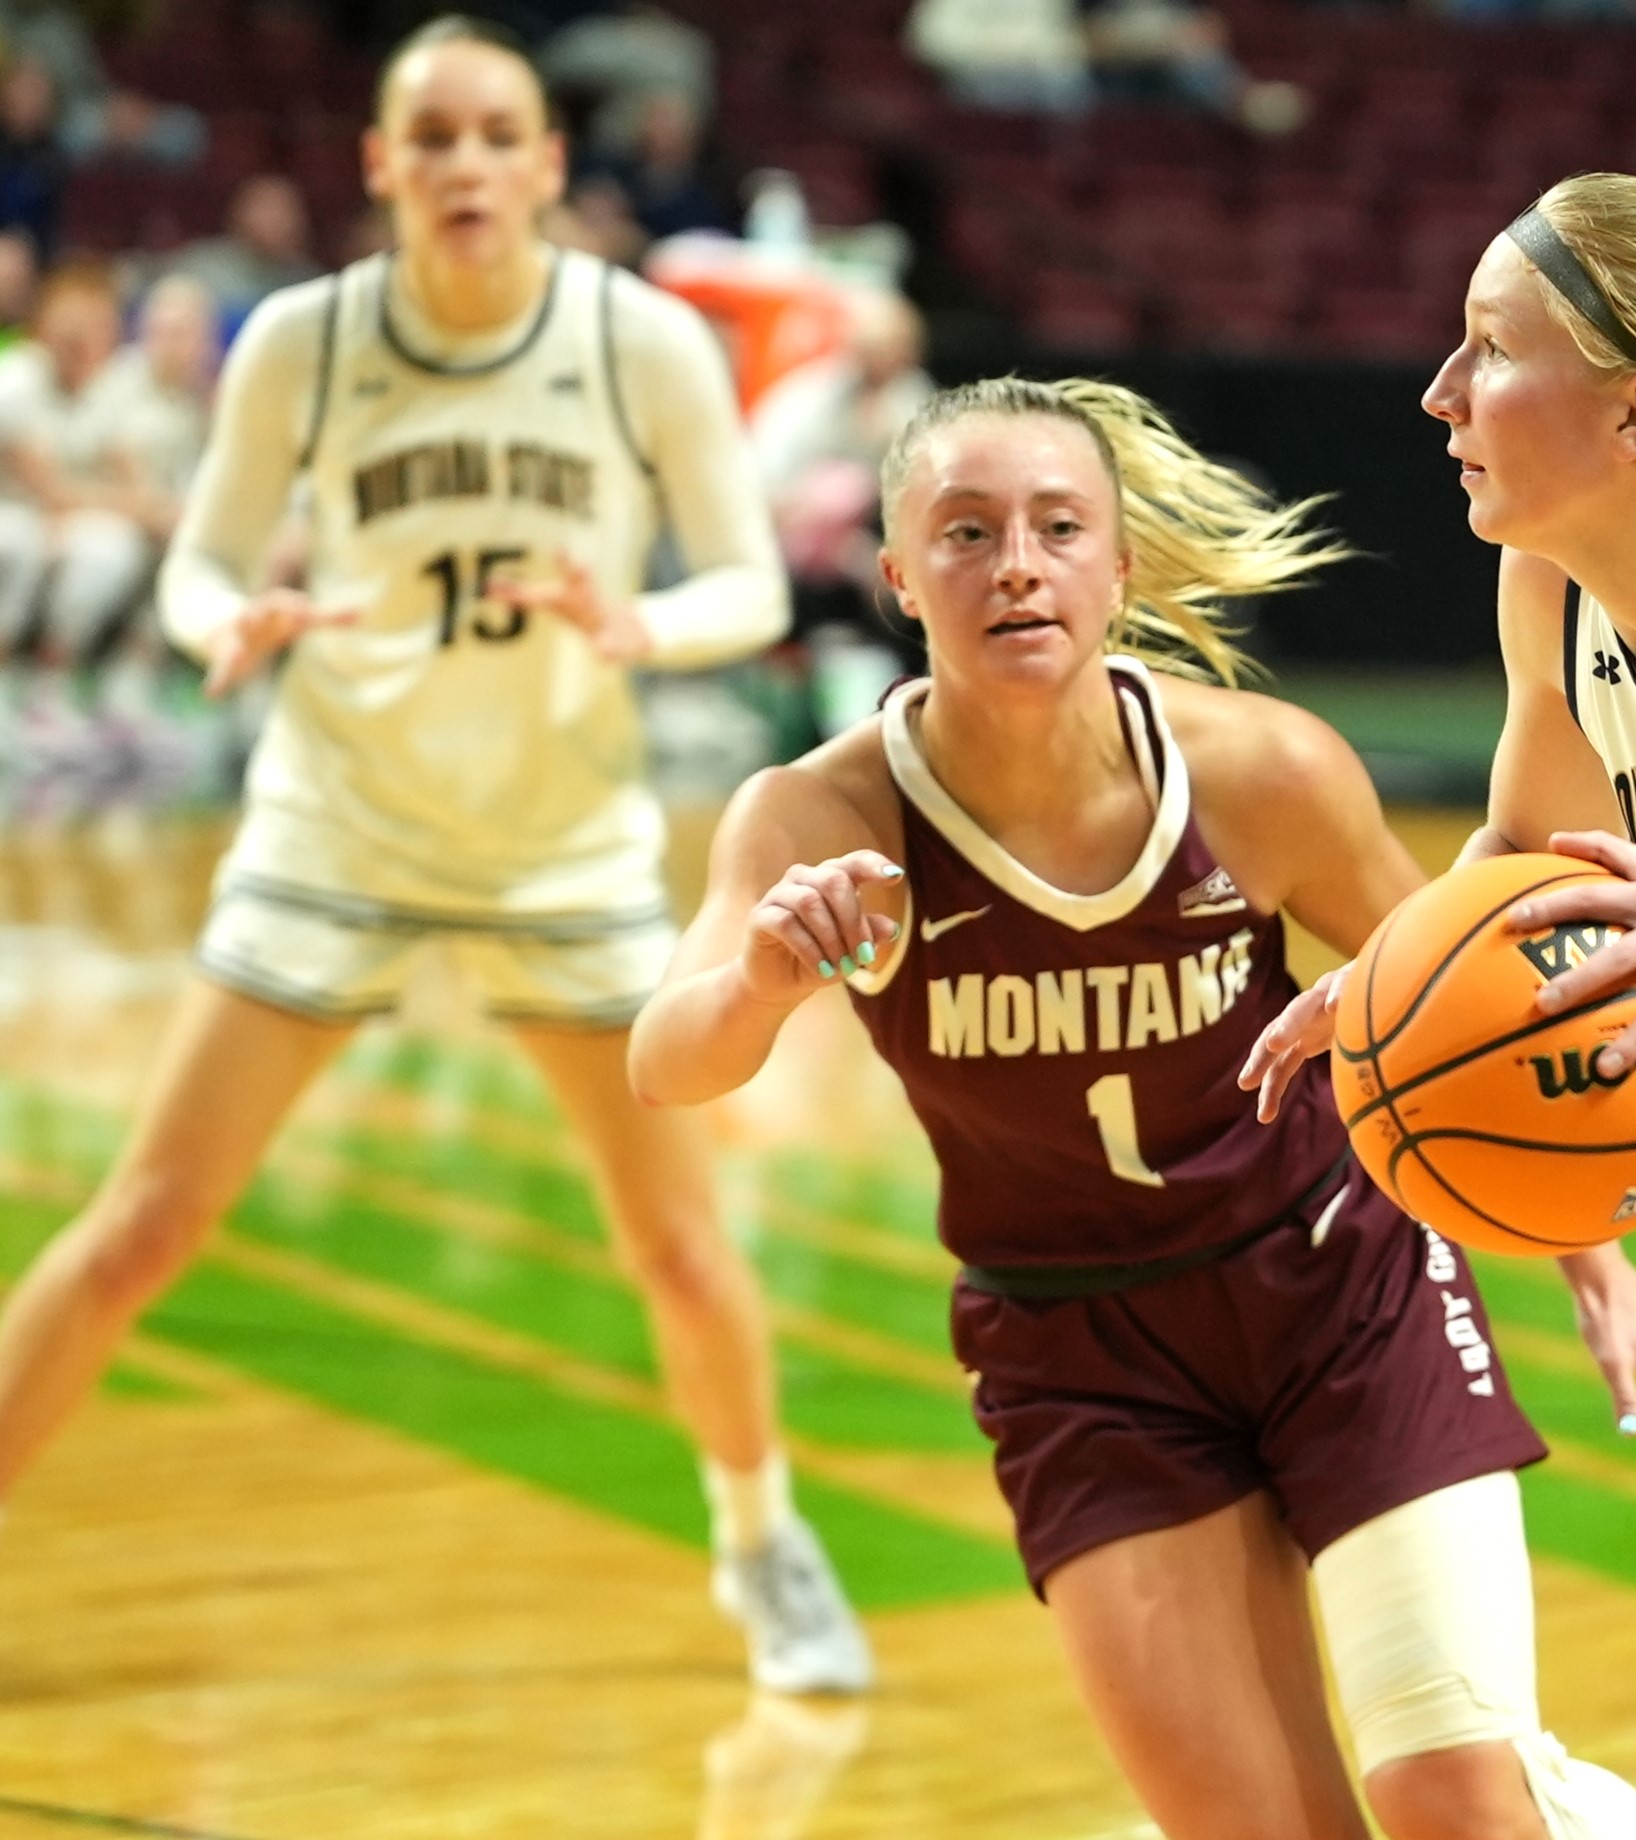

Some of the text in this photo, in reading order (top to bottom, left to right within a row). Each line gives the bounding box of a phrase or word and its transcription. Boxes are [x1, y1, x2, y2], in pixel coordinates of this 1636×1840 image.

[421, 548, 530, 647] 15
[928, 927, 1254, 1060] MONTANA
[1086, 1072, 1166, 1189] 1
[1439, 1289, 1495, 1398] LADY
